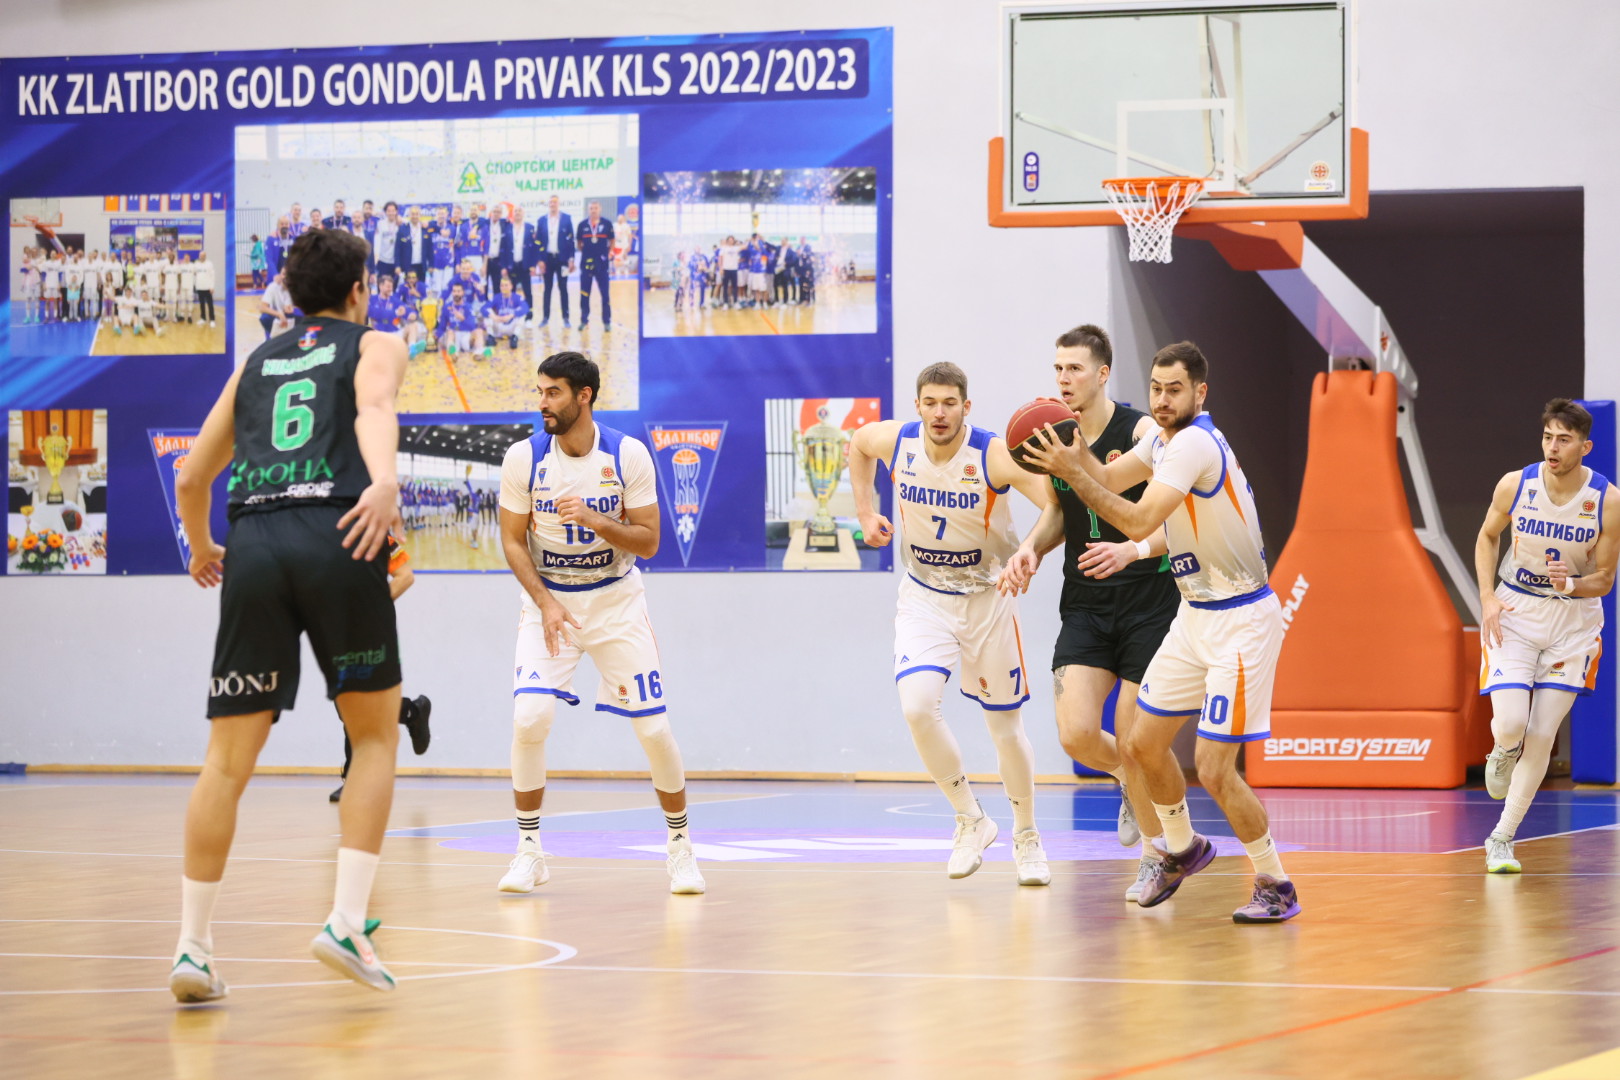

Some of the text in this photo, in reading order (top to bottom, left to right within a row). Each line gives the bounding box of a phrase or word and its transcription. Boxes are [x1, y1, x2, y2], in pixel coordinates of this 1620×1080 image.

[18, 47, 857, 116] KK ZLATIBOR GOLD GONDOLA PRVAK KLS 2022/2023
[485, 157, 615, 175] СПОРТСКИ ЦЕНТАР
[515, 178, 584, 192] ЧАЈЕТИНА
[272, 377, 317, 451] 6
[655, 431, 720, 448] ЗЛАТИБОР
[247, 457, 334, 491] DOHA
[535, 494, 619, 514] ЗЛБОР
[900, 482, 980, 509] ЗЛАТИБОР
[562, 523, 596, 545] 16
[931, 515, 947, 540] 7
[1087, 507, 1101, 538] 1
[1516, 516, 1595, 543] ЗЛАТИБОР
[546, 552, 610, 566] MOZZART
[913, 549, 978, 565] MOZZART
[634, 670, 663, 702] 16
[1009, 667, 1021, 695] 7
